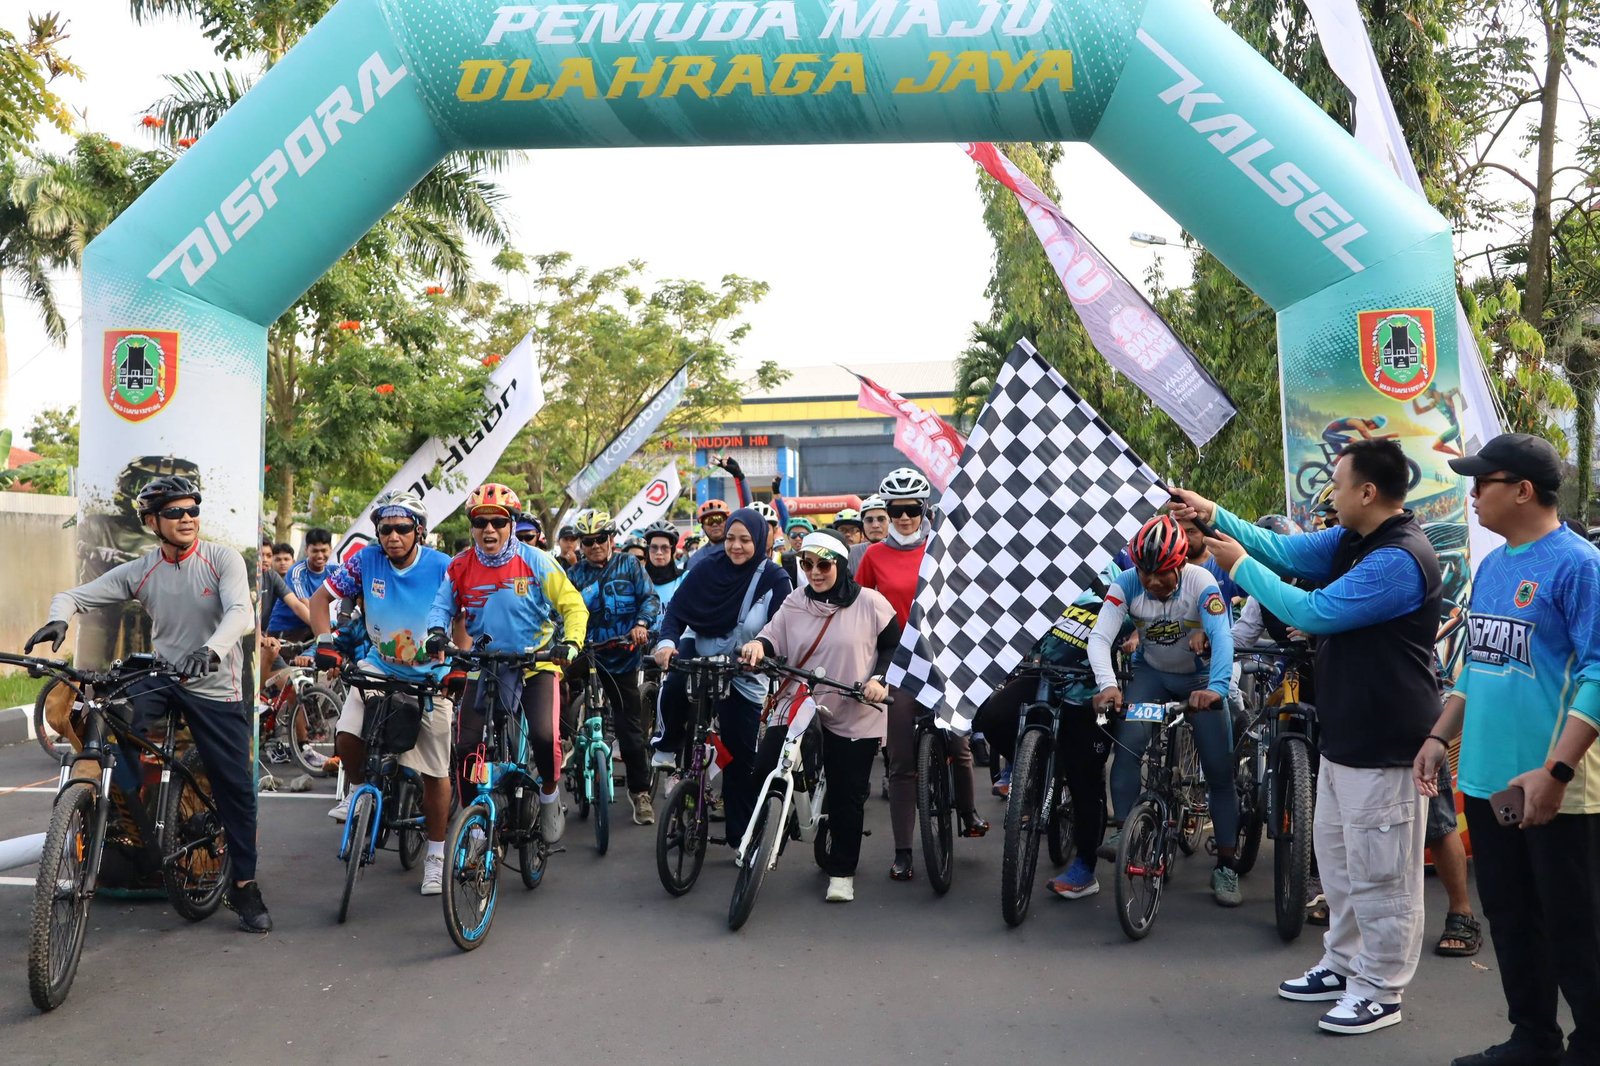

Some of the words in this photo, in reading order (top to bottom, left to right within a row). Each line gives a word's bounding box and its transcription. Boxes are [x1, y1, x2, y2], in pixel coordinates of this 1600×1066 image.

[482, 1, 801, 46] PEMUDA
[818, 0, 1053, 41] MAJU
[454, 51, 867, 102] OLAHRAGA
[892, 49, 1075, 94] JAYA
[146, 51, 408, 287] DISPORA
[1136, 27, 1368, 272] KALSEL
[749, 435, 768, 446] HM
[1134, 706, 1163, 720] 404
